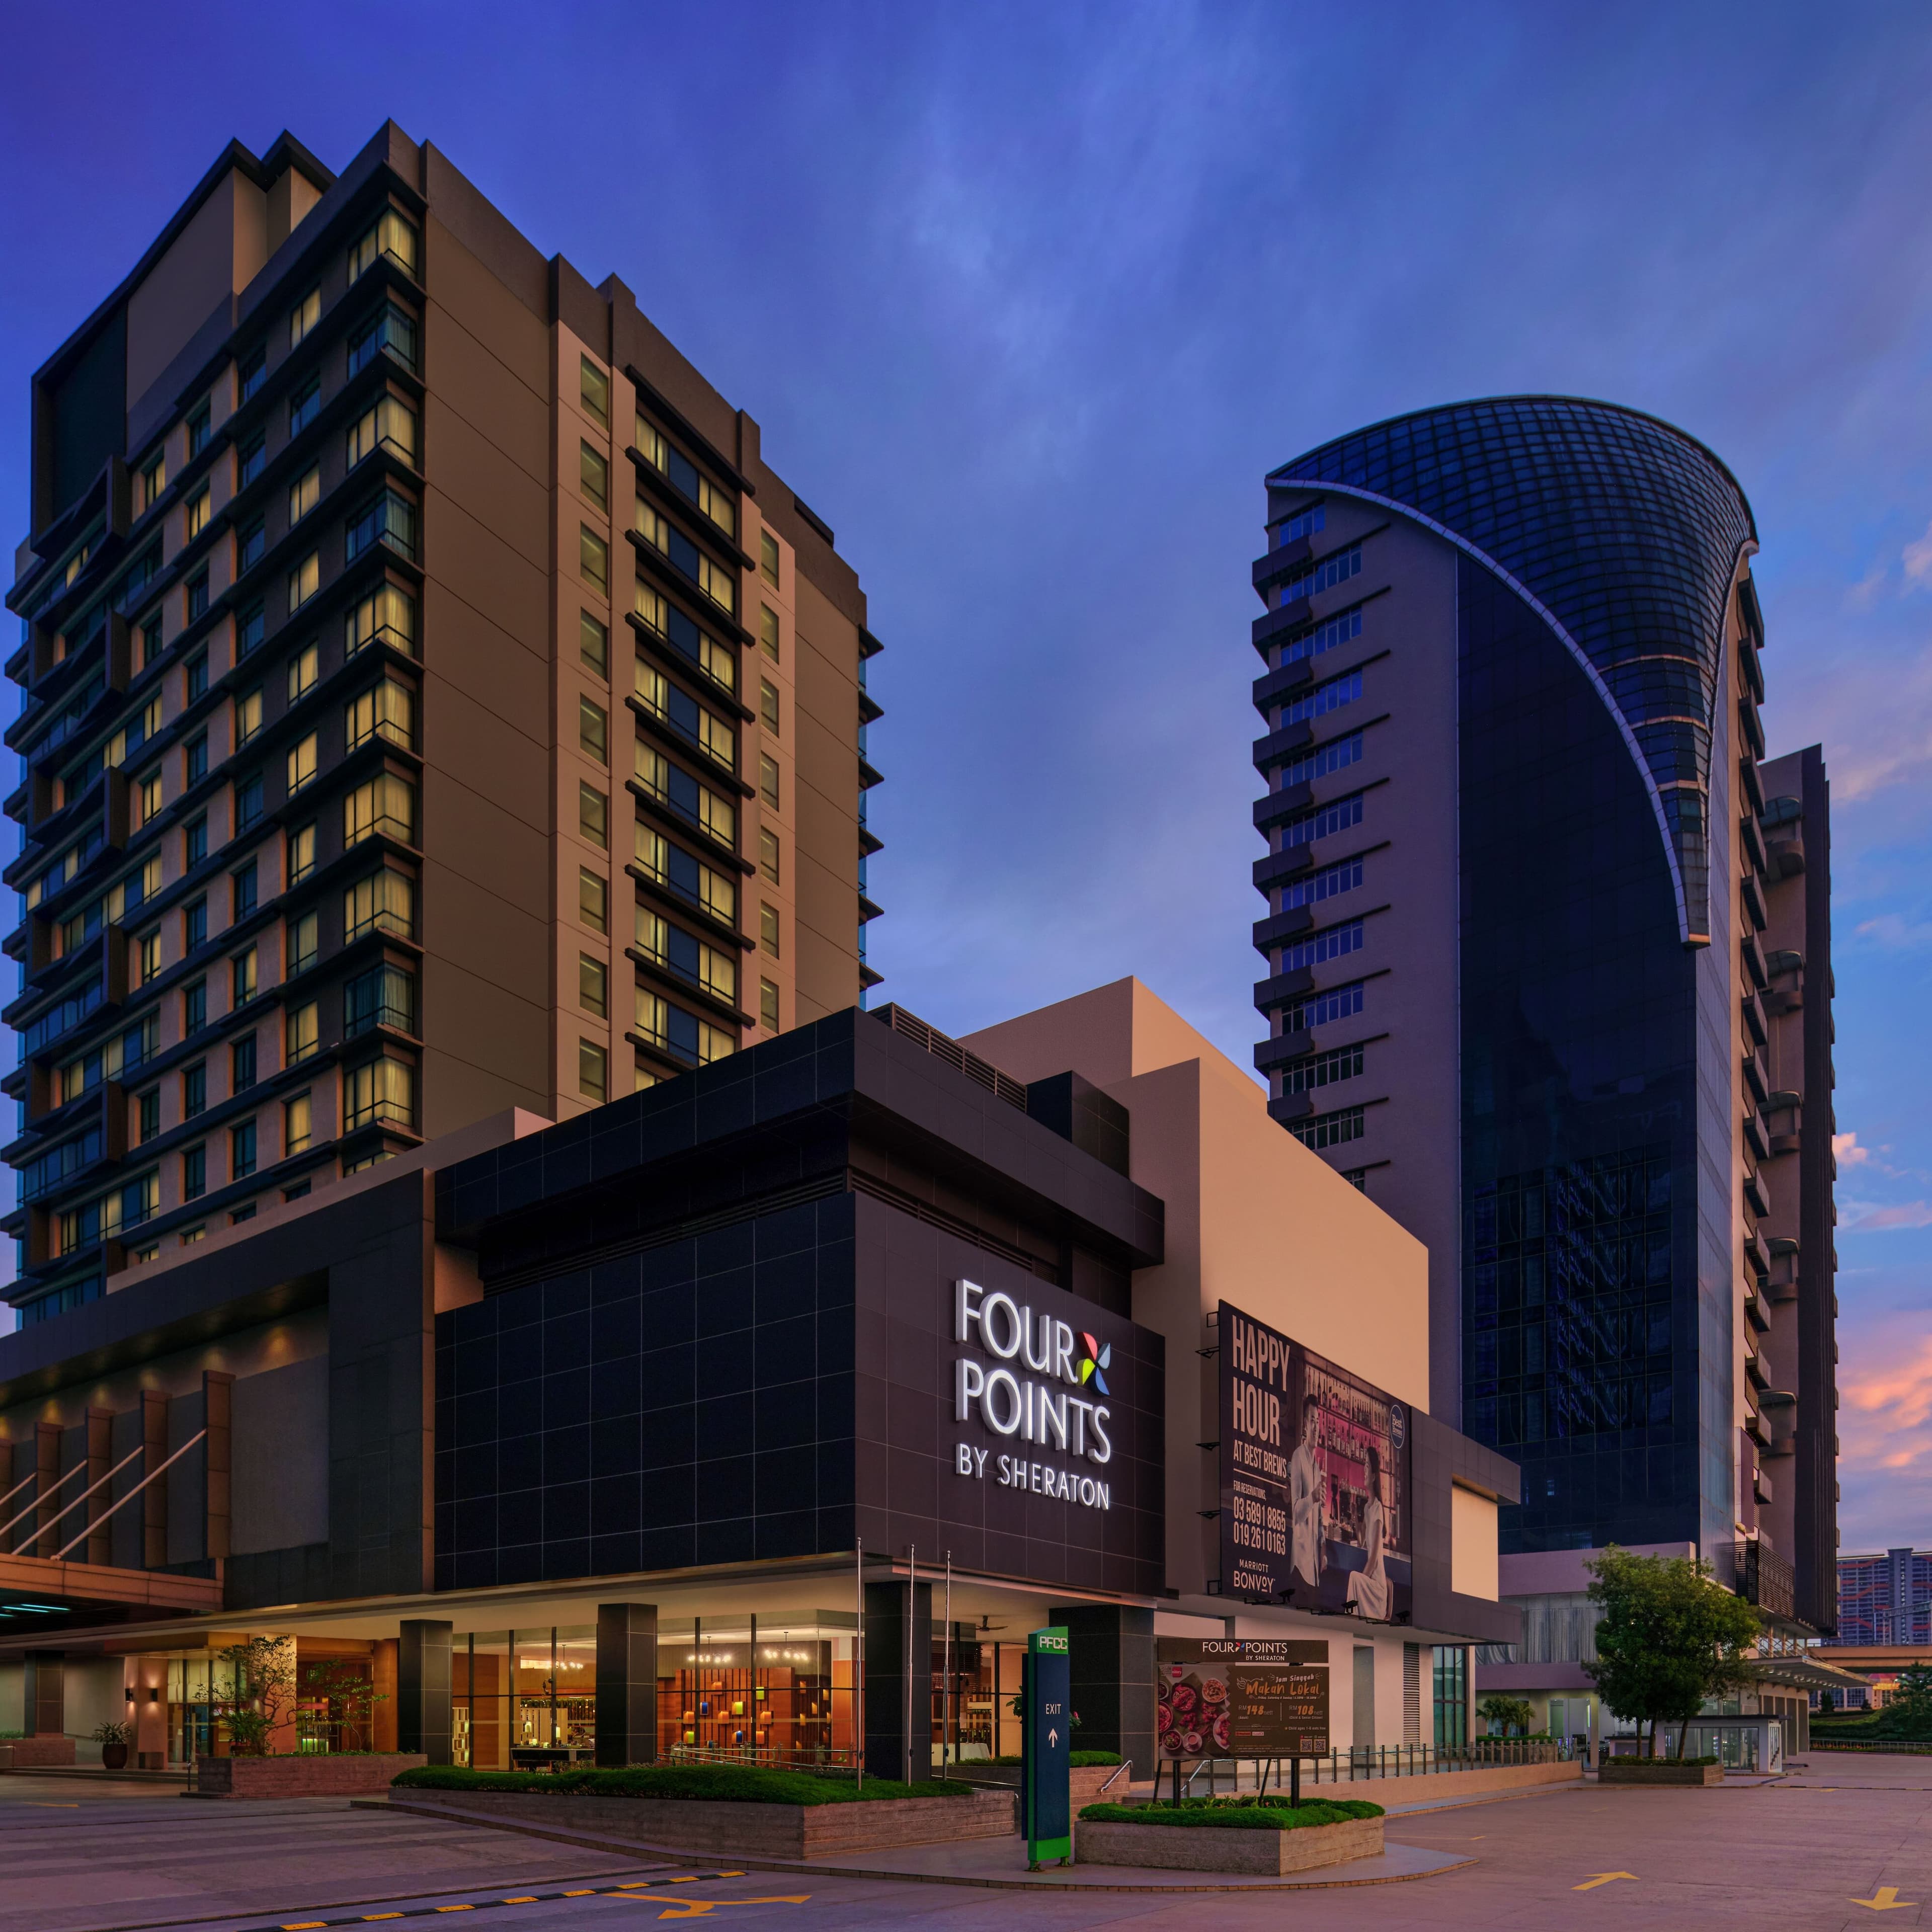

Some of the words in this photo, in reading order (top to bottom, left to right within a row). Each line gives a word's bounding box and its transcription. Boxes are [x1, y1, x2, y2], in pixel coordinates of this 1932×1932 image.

[956, 1279, 1078, 1384] FOUR
[1233, 1315, 1290, 1392] HAPPY
[956, 1358, 1111, 1464] POINTS
[1233, 1376, 1280, 1447] HOUR
[1392, 1414, 1402, 1429] Best
[1234, 1439, 1243, 1462] AT
[1244, 1443, 1263, 1469] BEST
[1264, 1448, 1287, 1478] BREWS
[956, 1443, 989, 1479] BY
[997, 1455, 1109, 1510] SHERATON
[1233, 1480, 1241, 1492] FOR
[1234, 1496, 1245, 1520] 03
[1246, 1499, 1265, 1525] 5891
[1267, 1506, 1286, 1532] 8855
[1234, 1520, 1250, 1546] 019
[1251, 1525, 1265, 1550] 261
[1267, 1530, 1286, 1555] 0163
[1239, 1559, 1269, 1573] MARRIOTT
[1234, 1570, 1274, 1593] BONVOY
[1039, 1636, 1068, 1650] PFCC
[1202, 1642, 1235, 1653] FOUR
[1245, 1642, 1287, 1653] POINTS
[1246, 1681, 1284, 1695] Makan
[1290, 1682, 1319, 1696] Lokal
[1045, 1704, 1061, 1715] EXIT
